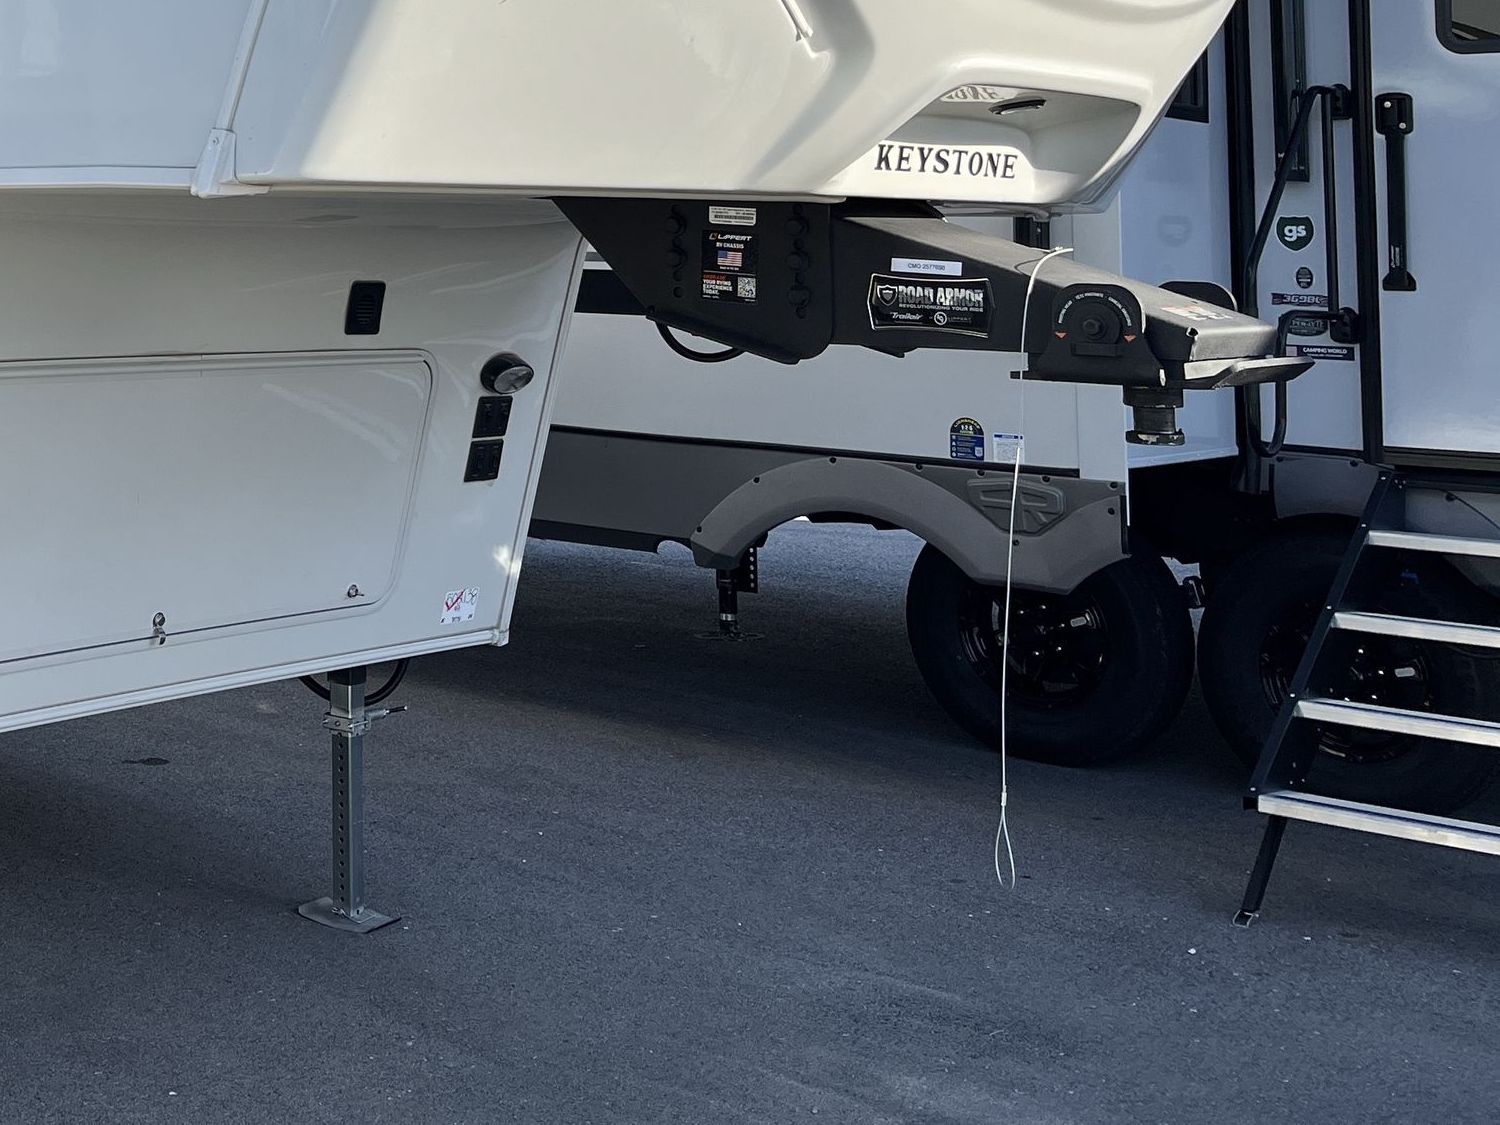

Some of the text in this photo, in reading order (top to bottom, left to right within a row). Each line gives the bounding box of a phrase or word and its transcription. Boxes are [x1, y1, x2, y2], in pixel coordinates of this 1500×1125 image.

[874, 144, 1018, 179] KEYSTONE
[1283, 224, 1307, 242] gs
[898, 285, 984, 307] ROAD ARMOR
